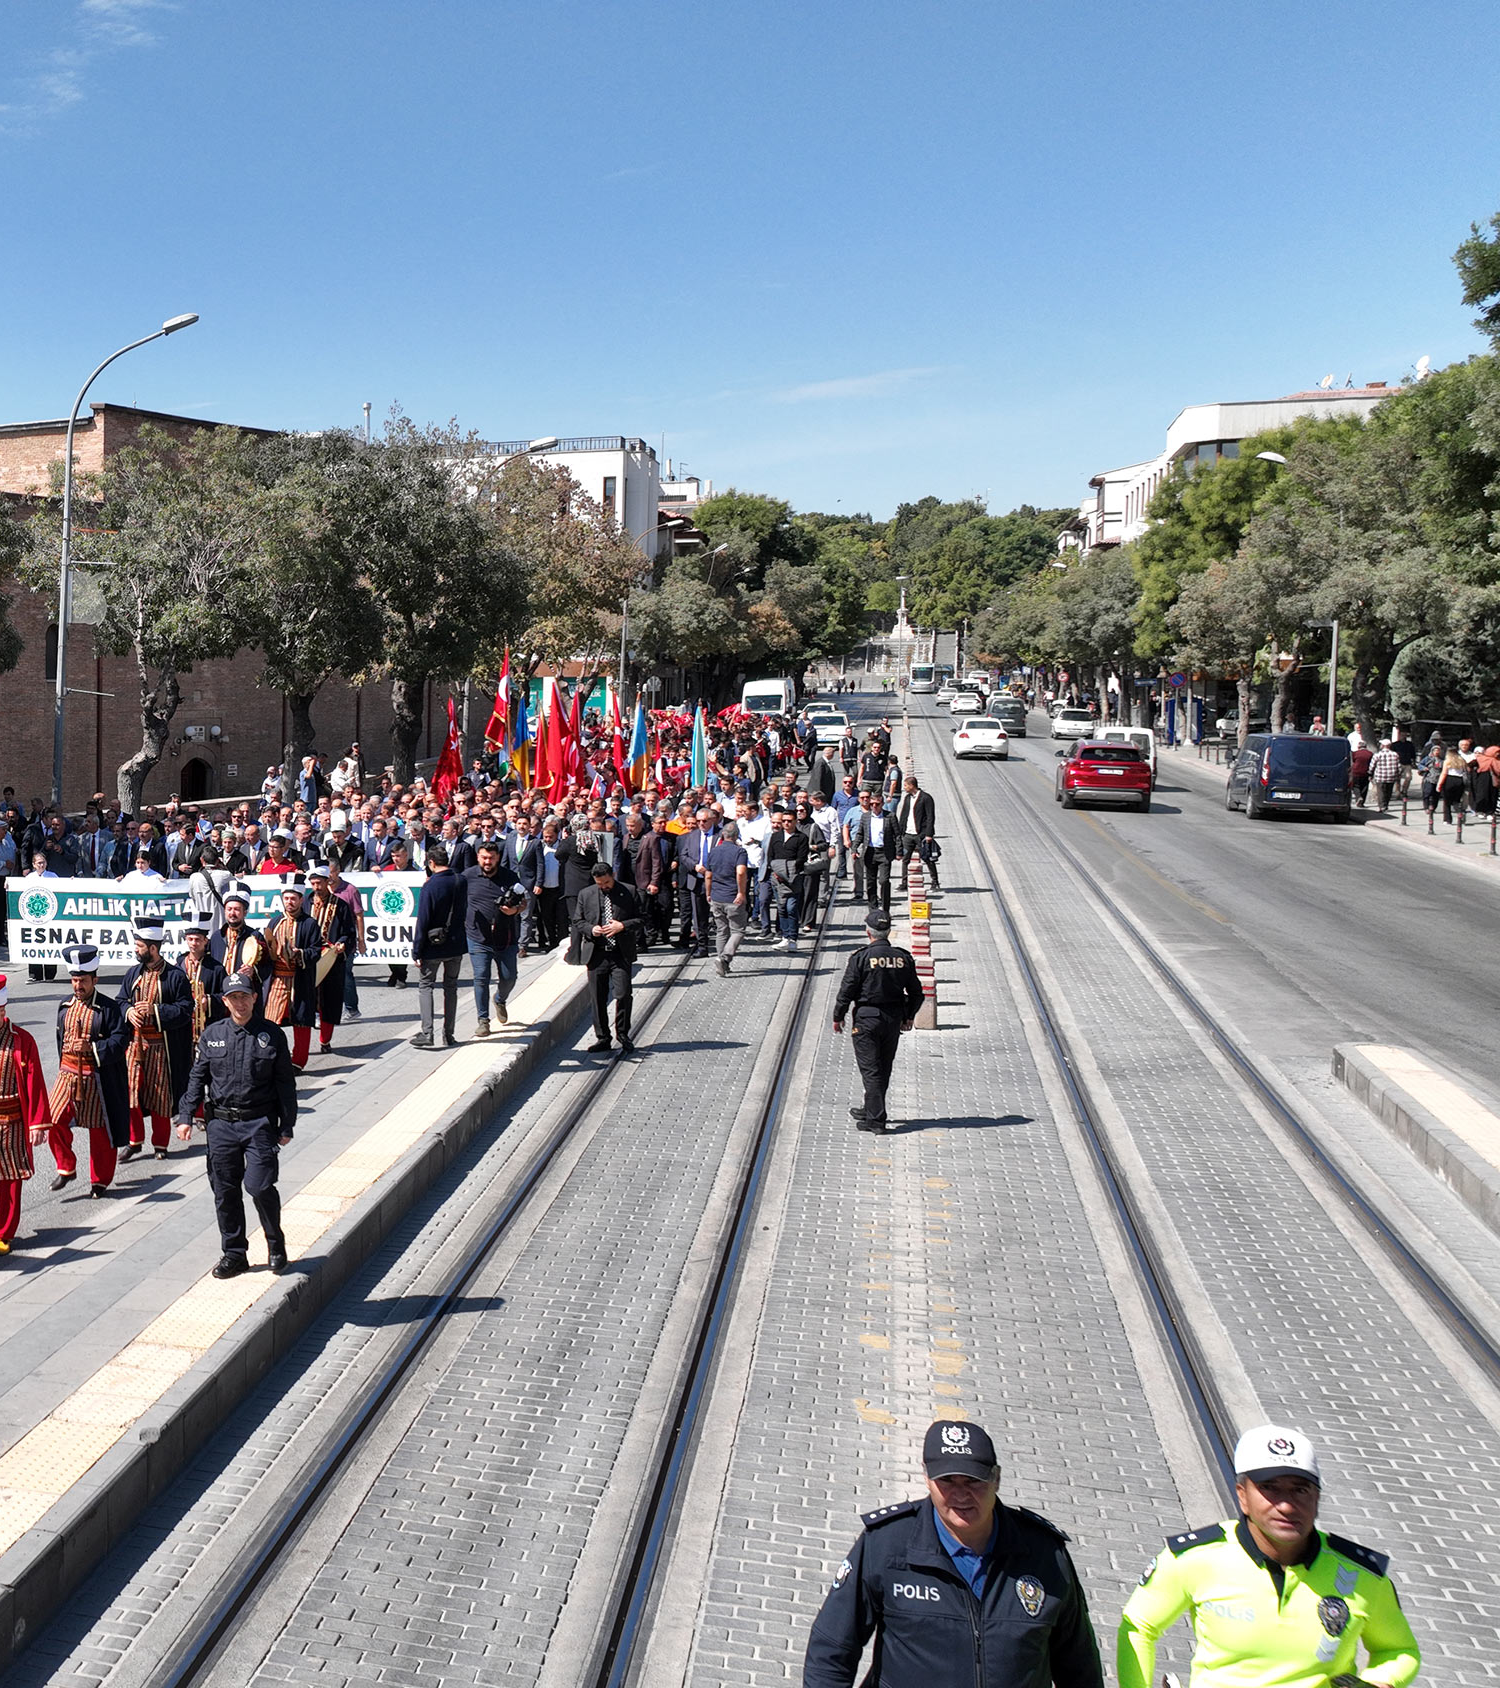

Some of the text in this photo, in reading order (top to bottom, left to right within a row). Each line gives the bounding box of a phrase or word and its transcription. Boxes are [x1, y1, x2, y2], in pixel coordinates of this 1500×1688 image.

[130, 898, 198, 916] HAFTA
[20, 927, 94, 945] ESNAF
[365, 925, 414, 943] SUN
[21, 948, 62, 959] KONYA
[107, 951, 123, 960] VE
[869, 957, 905, 969] POLIS
[893, 1583, 941, 1602] POLİS
